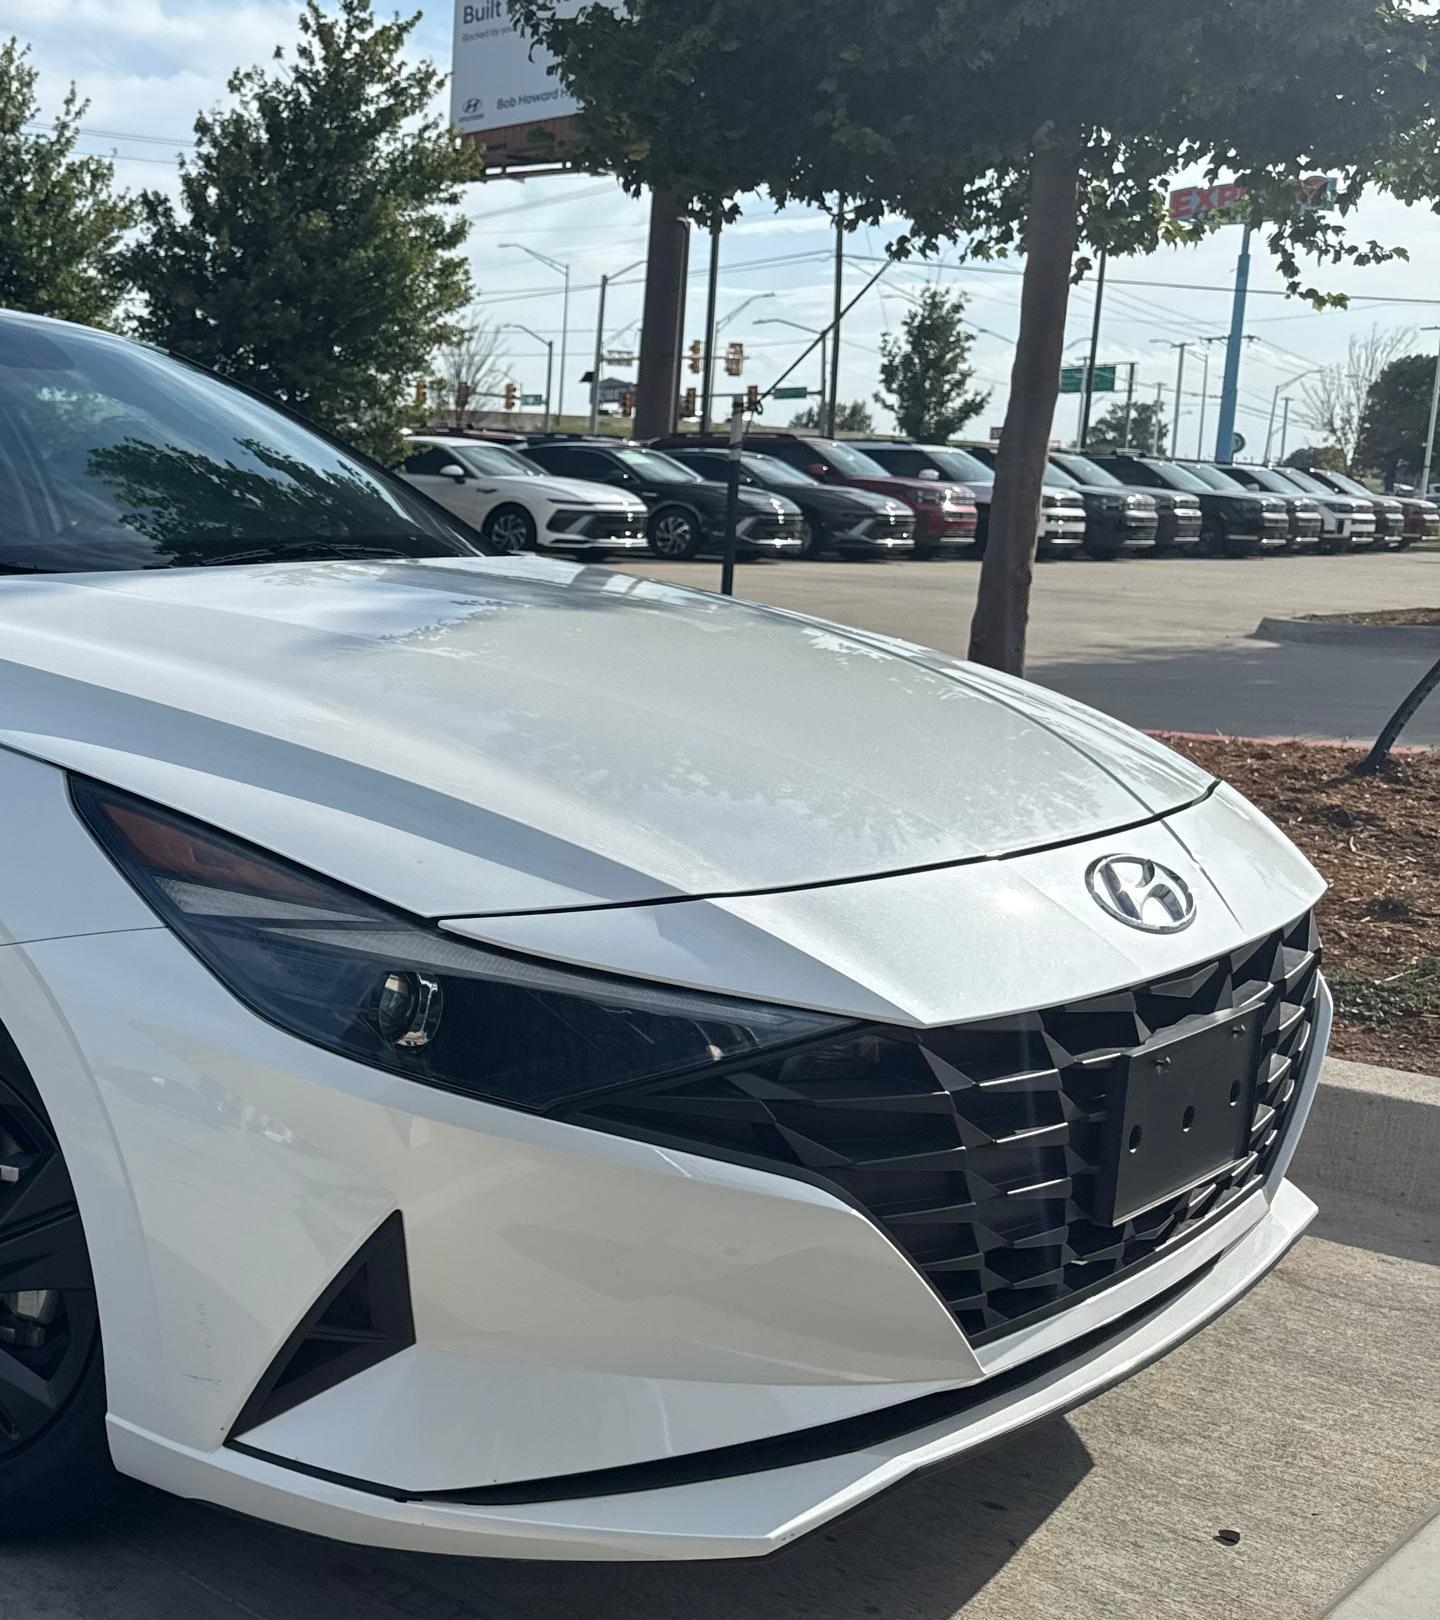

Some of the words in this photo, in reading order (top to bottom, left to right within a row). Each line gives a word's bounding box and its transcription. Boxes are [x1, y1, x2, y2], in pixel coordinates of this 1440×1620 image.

[463, 0, 502, 24] Built
[496, 95, 517, 110] Bob
[518, 88, 559, 106] Howard
